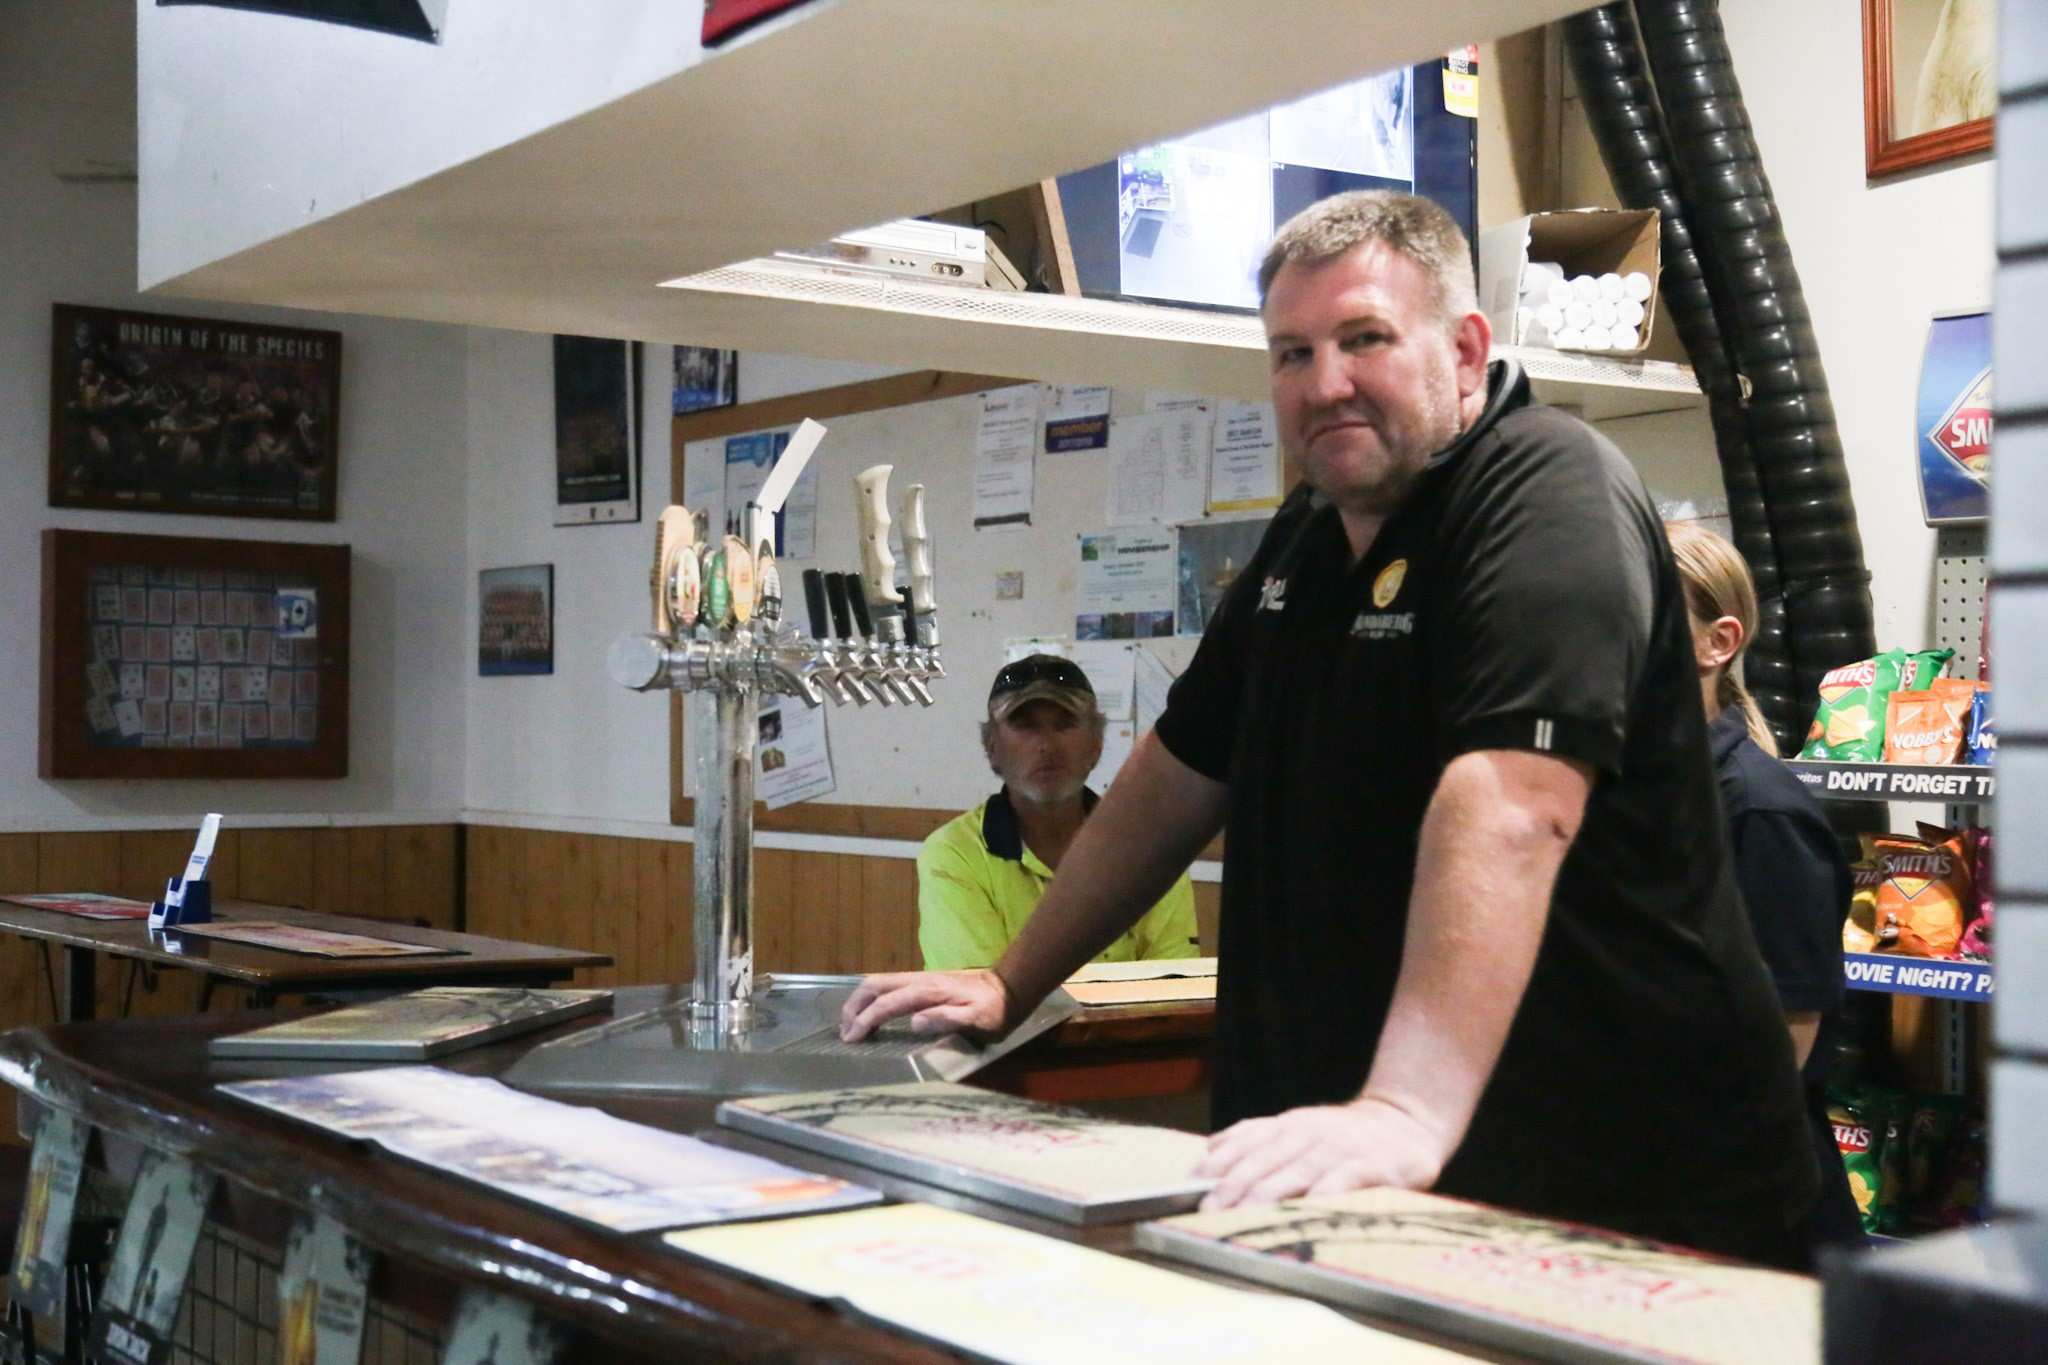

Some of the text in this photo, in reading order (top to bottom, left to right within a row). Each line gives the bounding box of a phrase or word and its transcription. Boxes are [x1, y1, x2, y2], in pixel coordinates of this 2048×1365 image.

[119, 321, 324, 360] ORIGIN OF THE SPECIES
[1827, 771, 1887, 792] DON'T
[1890, 774, 1971, 795] FORGET
[1883, 854, 1952, 874] SMITH'S
[1896, 966, 1973, 991] NIGHT?
